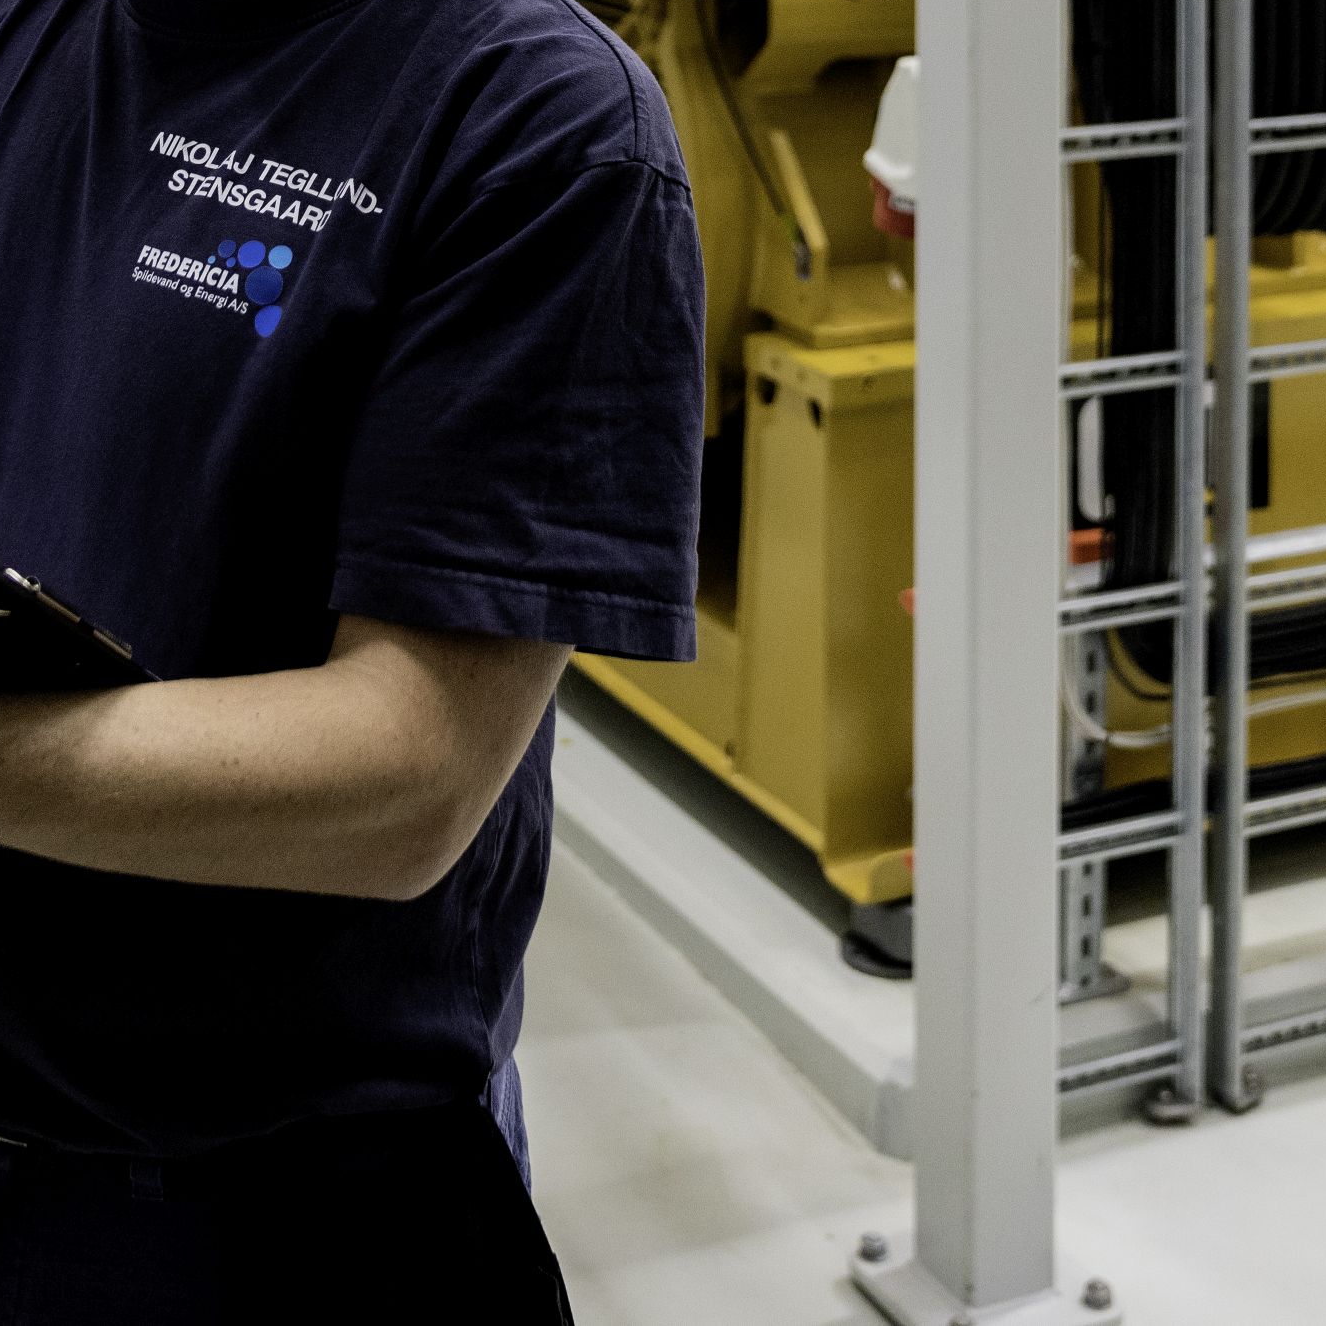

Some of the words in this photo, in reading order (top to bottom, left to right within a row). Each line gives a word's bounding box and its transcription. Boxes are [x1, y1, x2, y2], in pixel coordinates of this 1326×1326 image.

[150, 131, 255, 175] NIKOLAJ
[167, 168, 333, 232] STENSGAARD
[132, 266, 181, 291] Spildevand
[180, 284, 194, 298] og
[194, 285, 229, 310] Energi
[227, 297, 250, 315] A/S
[137, 244, 240, 294] FREDERICIA
